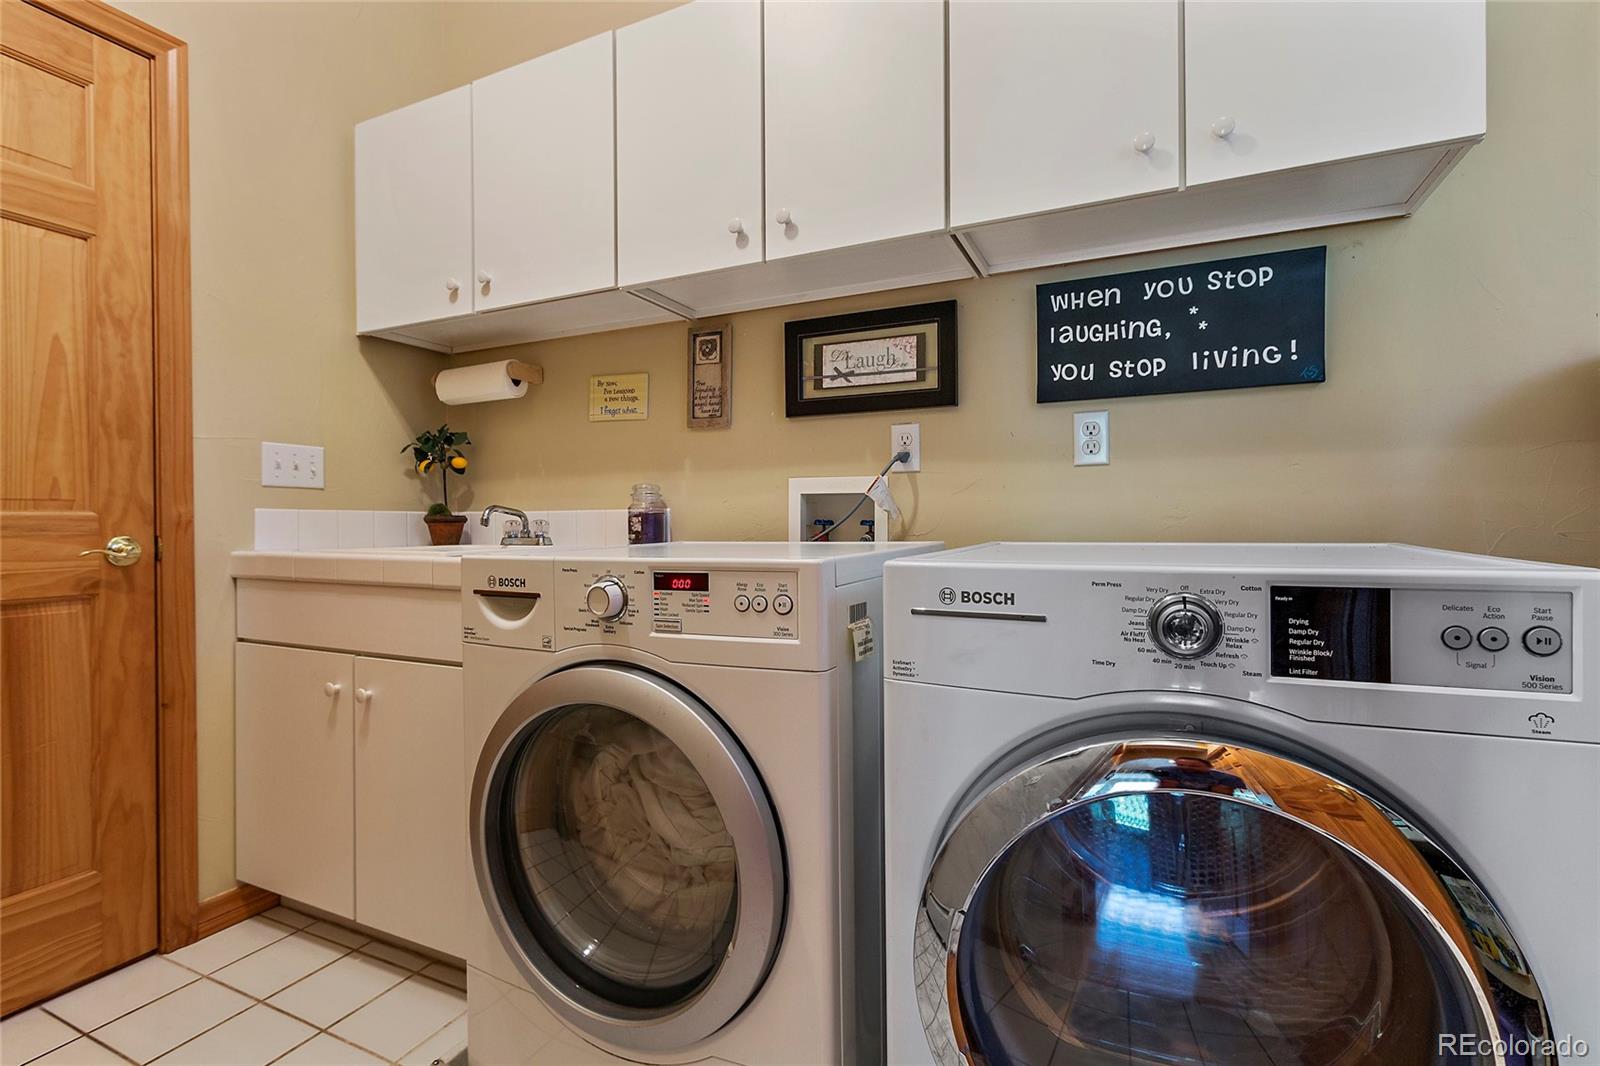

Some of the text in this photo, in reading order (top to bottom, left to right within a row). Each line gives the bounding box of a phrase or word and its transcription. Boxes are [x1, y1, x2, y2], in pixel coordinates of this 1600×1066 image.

[845, 347, 896, 372] Laugh
[498, 578, 526, 588] BOSCH
[672, 579, 691, 589] 000
[961, 591, 1015, 605] BOSCH
[1288, 618, 1309, 626] Drying
[1289, 638, 1325, 647] Regular Dry
[1465, 661, 1487, 670] Signal
[1529, 674, 1555, 682] Vision
[1538, 682, 1563, 690] Series
